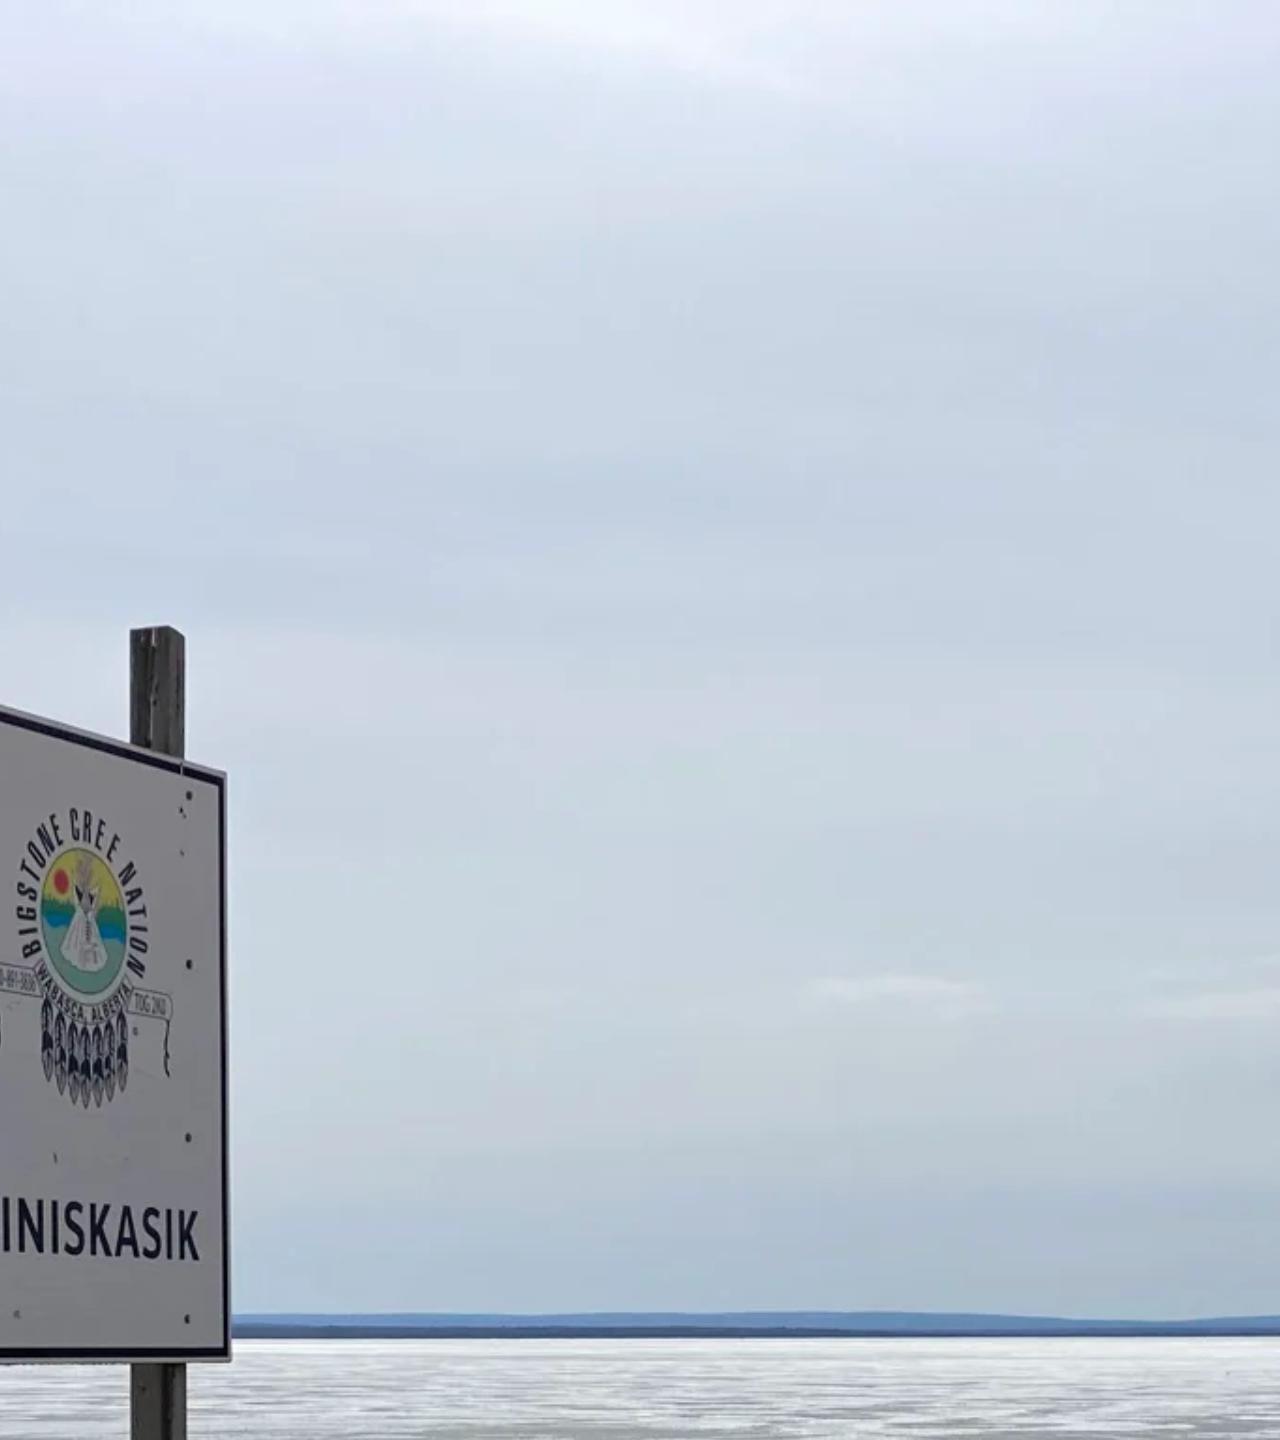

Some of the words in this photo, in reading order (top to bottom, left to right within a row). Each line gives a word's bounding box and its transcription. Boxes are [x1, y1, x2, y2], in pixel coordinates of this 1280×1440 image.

[16, 813, 64, 959] BIGSTONE
[70, 807, 121, 863] CREE
[118, 861, 149, 979] NATION
